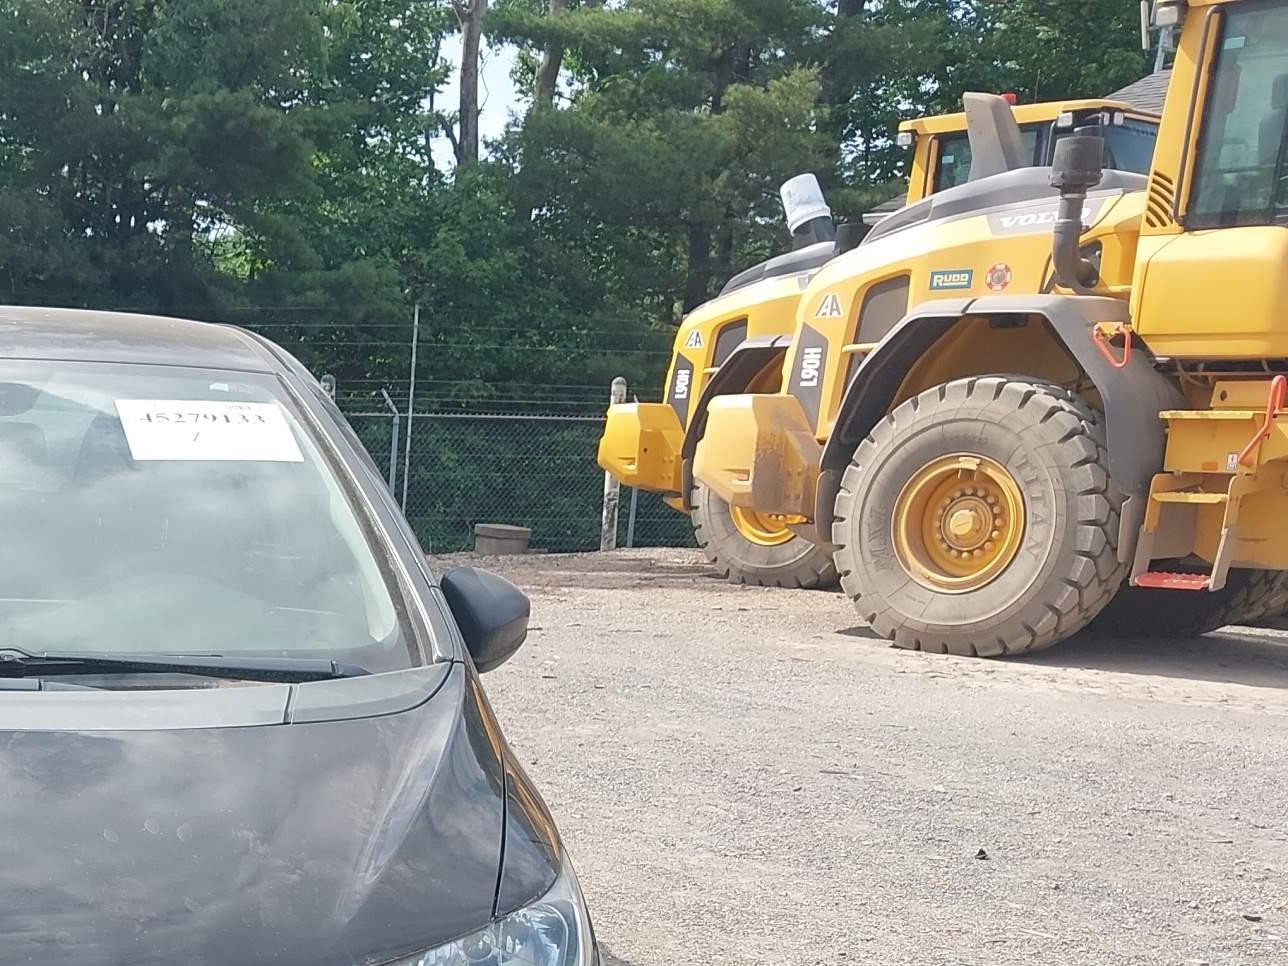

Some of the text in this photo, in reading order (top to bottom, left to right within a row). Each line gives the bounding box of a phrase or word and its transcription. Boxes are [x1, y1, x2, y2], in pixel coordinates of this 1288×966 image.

[933, 273, 969, 287] RUDD
[799, 347, 823, 387] L90H
[674, 369, 690, 399] L90H
[139, 412, 266, 425] 45279133
